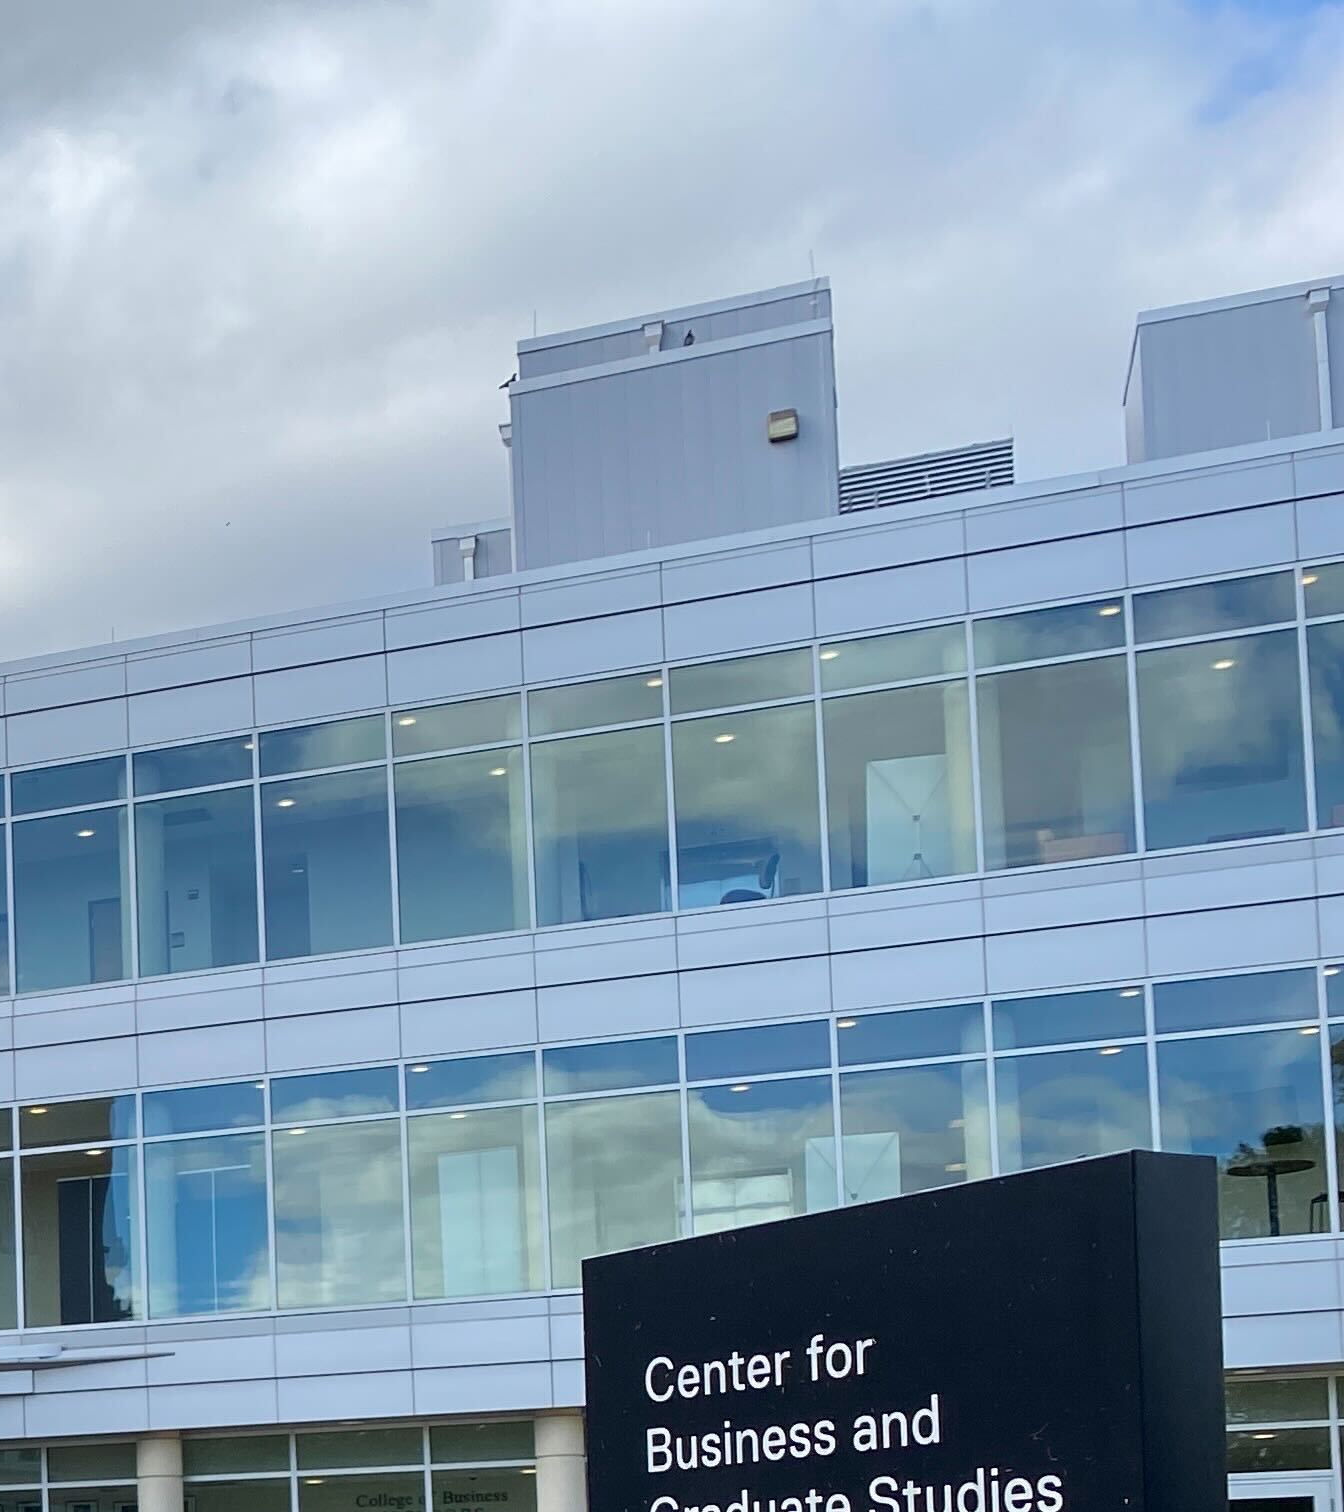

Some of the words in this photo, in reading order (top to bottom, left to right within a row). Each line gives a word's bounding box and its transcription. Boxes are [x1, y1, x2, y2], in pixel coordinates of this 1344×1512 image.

[645, 1350, 791, 1402] Center
[805, 1334, 875, 1382] for
[646, 1420, 836, 1473] Business
[852, 1393, 940, 1452] and
[355, 1493, 413, 1509] College
[442, 1490, 509, 1505] Business
